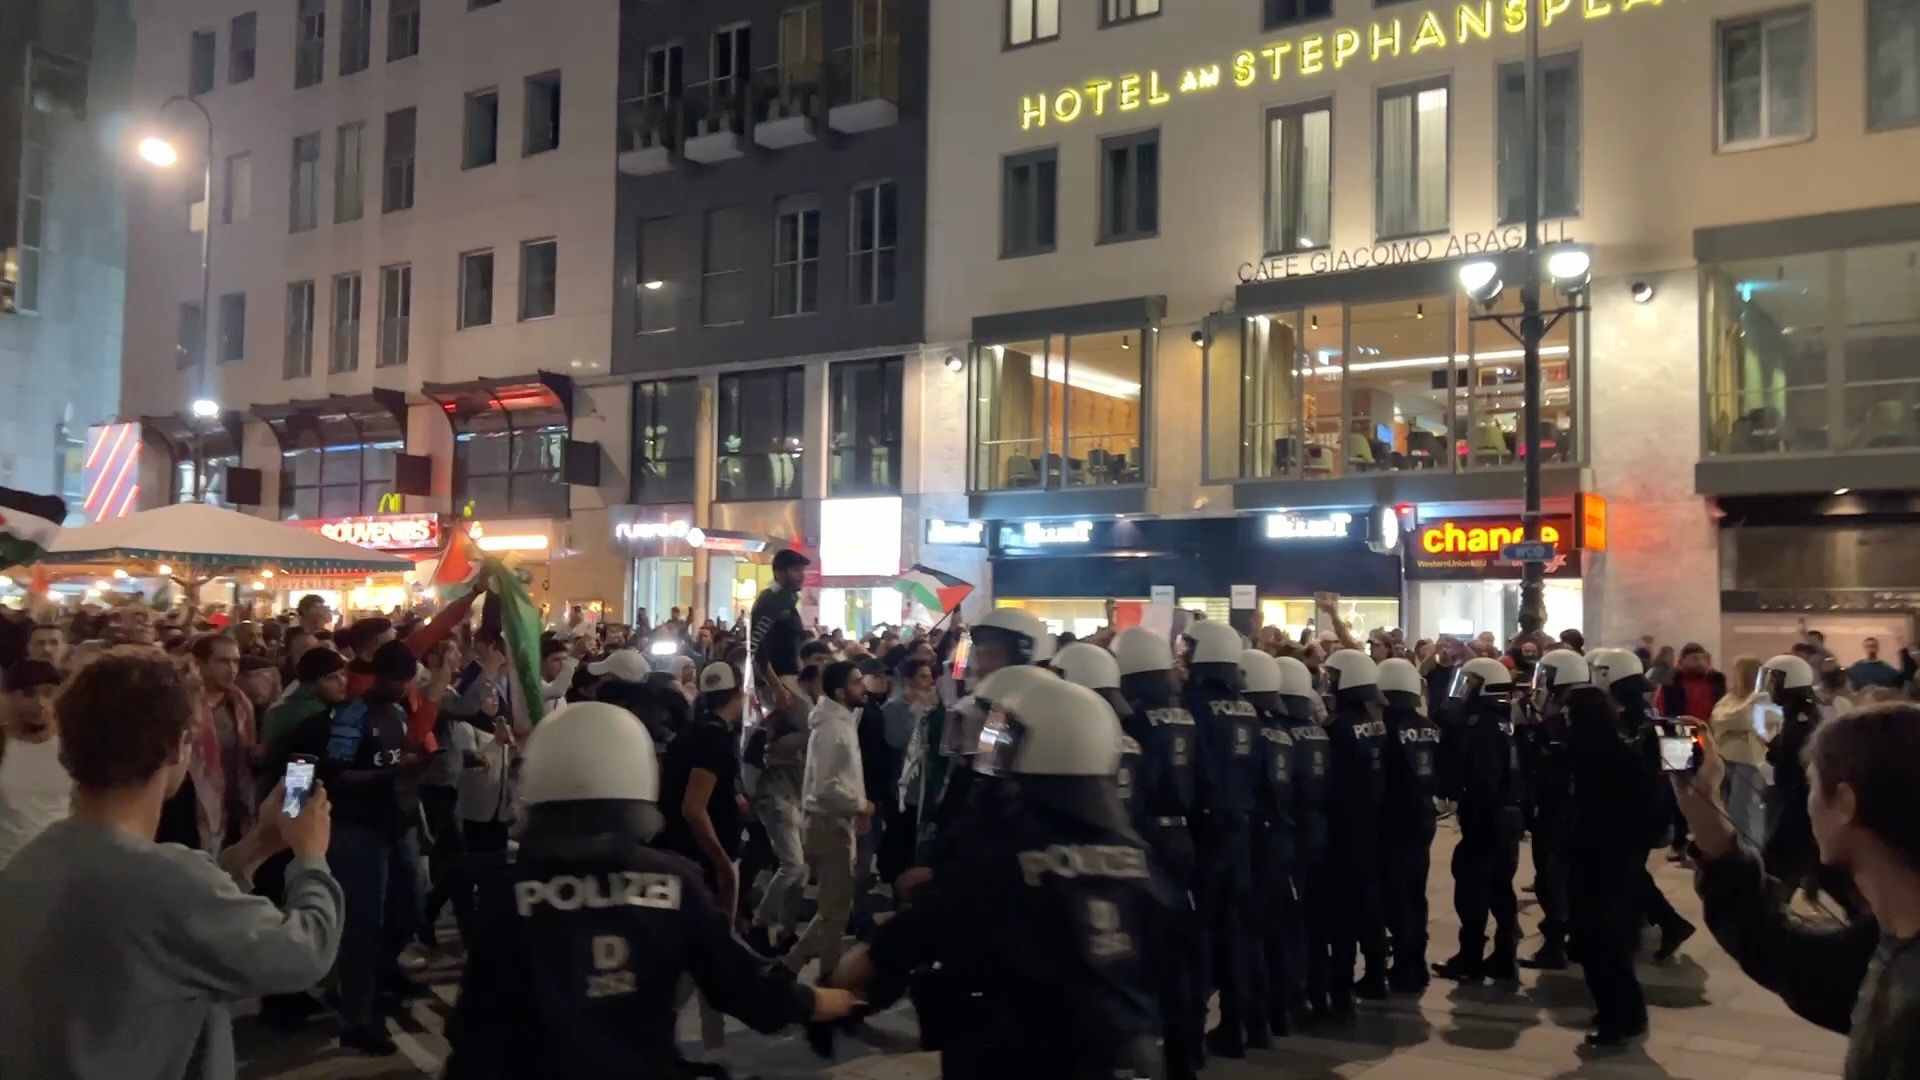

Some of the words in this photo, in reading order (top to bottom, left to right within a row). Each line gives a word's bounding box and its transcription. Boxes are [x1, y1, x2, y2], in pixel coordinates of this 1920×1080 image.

[1021, 69, 1170, 130] HOTEL
[1180, 65, 1219, 93] AM
[1236, 256, 1300, 285] CAFE
[1309, 238, 1432, 275] GIACOMO
[1444, 220, 1575, 259] ARAGLL
[1422, 522, 1559, 554] chane
[514, 871, 682, 917] POLIZEI
[592, 934, 630, 970] D
